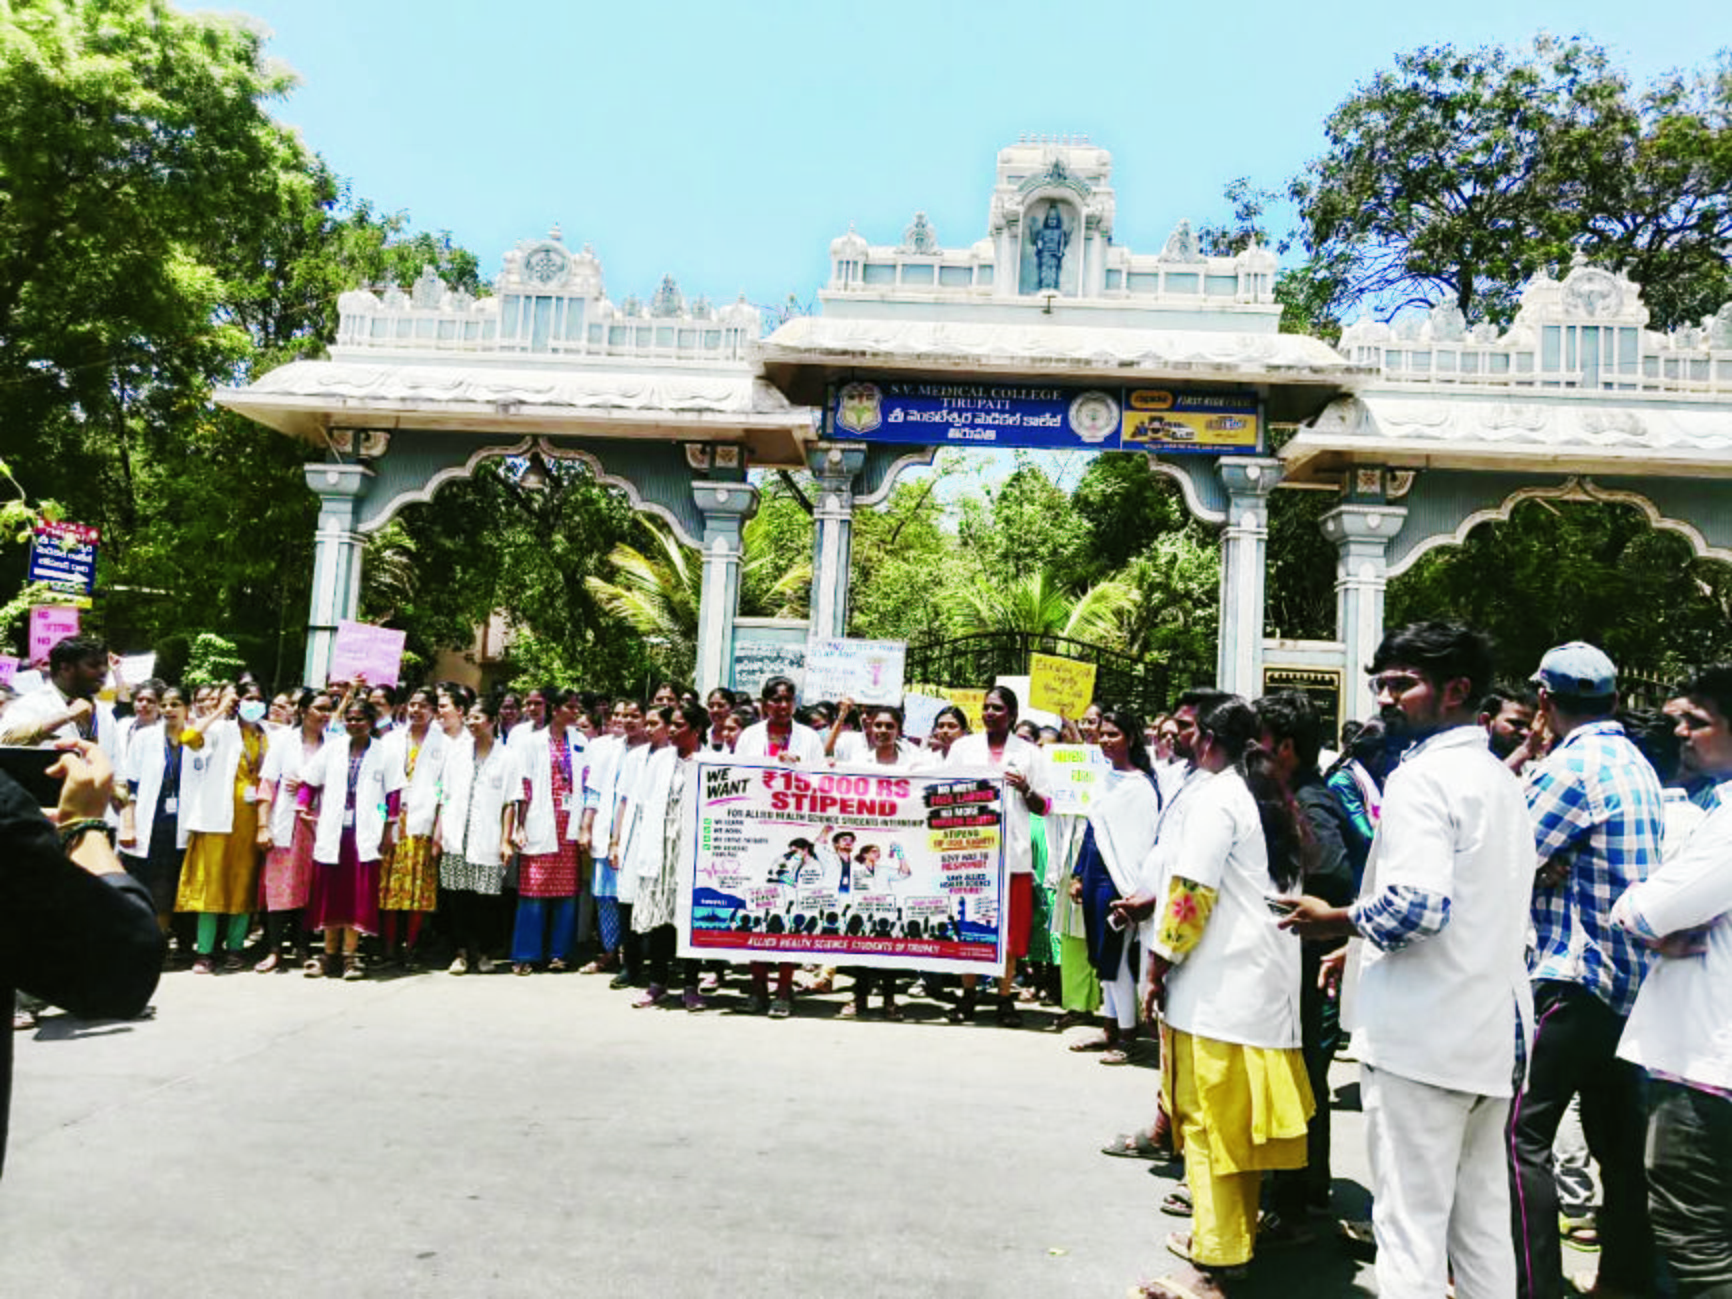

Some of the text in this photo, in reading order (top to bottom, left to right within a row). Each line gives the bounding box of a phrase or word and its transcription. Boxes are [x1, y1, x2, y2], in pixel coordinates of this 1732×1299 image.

[918, 386, 986, 398] MEDICAL
[991, 388, 1062, 400] COLLEGE
[940, 397, 1010, 410] TIRUPATI
[706, 768, 731, 783] WE
[706, 778, 751, 799] WANT
[761, 770, 910, 798] ₹15,000 RS
[771, 791, 897, 817] STIPEND
[727, 808, 743, 817] FOR
[745, 809, 774, 819] ALLIED
[775, 811, 805, 821] HEALTH
[808, 813, 840, 824] SCIENCE
[841, 816, 879, 826] STUDENTS
[747, 937, 777, 947] ALLIED
[780, 938, 811, 948] HEALTH
[814, 939, 848, 949] SCIENCE
[852, 941, 893, 952] STUDENTS
